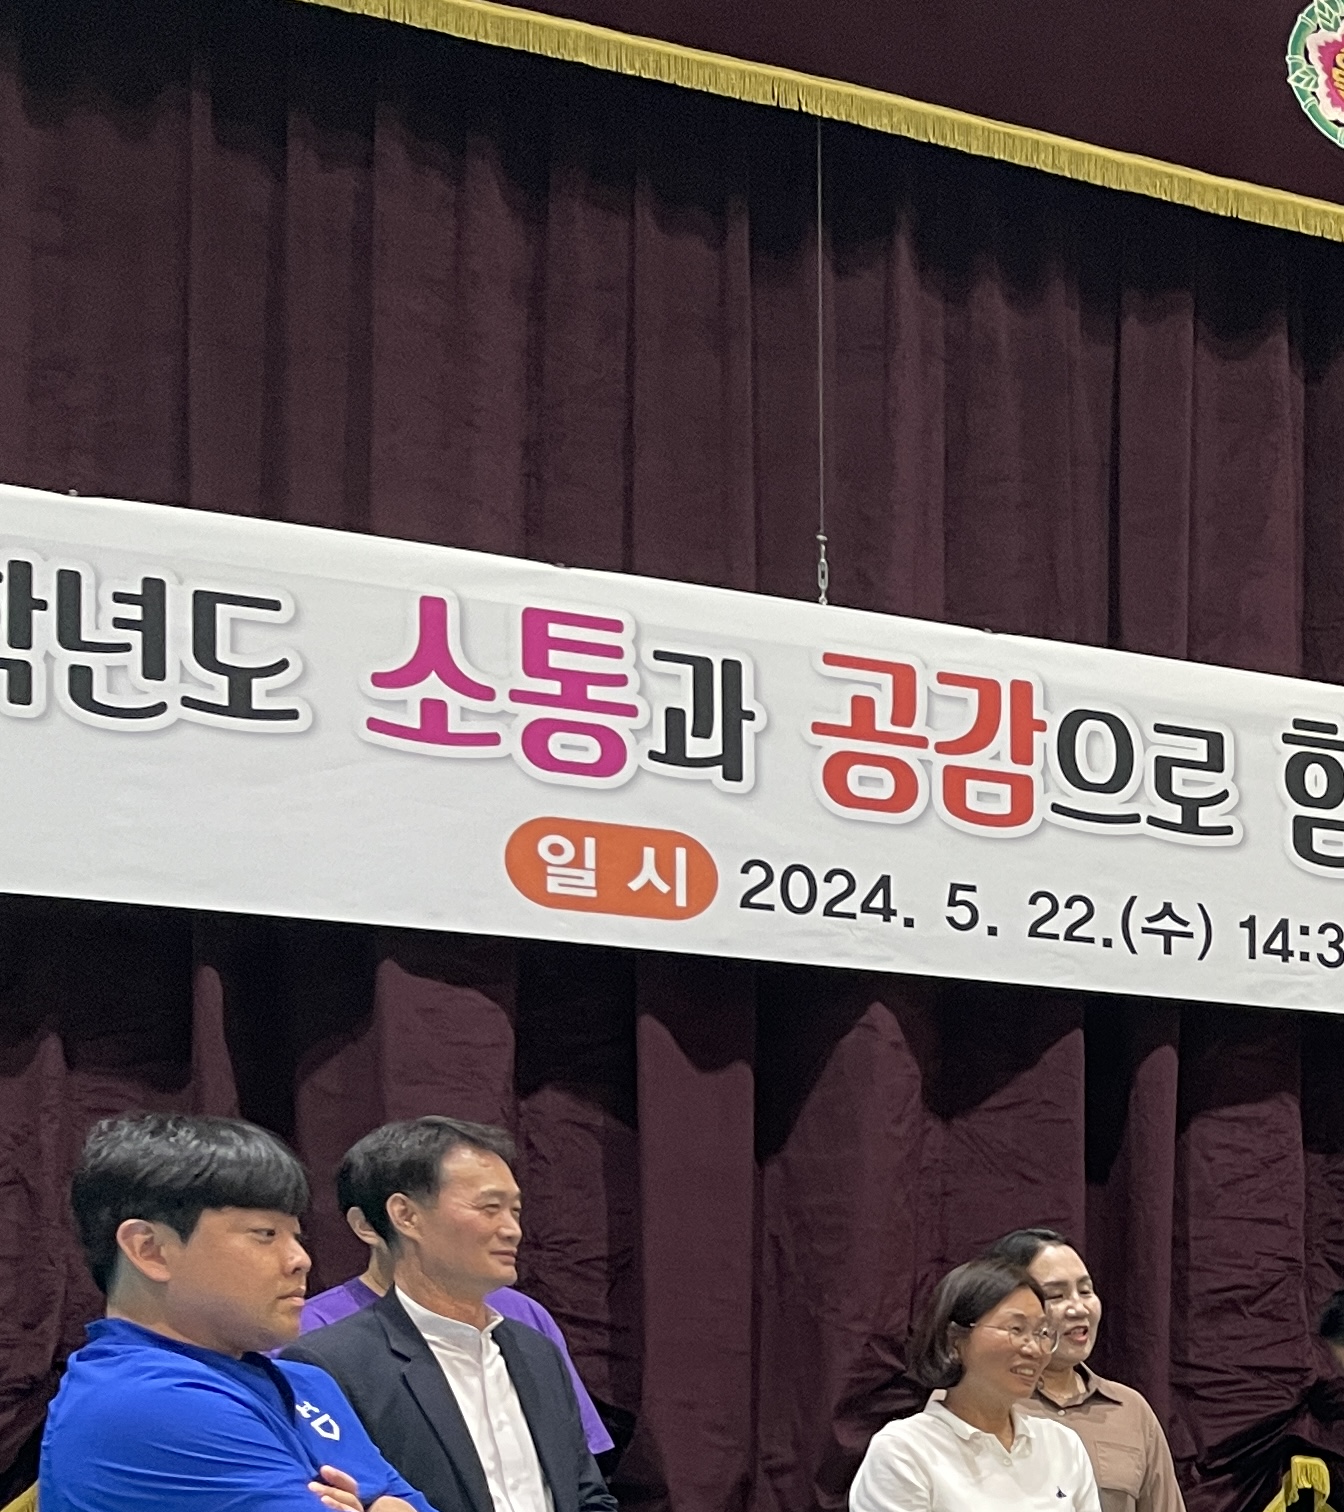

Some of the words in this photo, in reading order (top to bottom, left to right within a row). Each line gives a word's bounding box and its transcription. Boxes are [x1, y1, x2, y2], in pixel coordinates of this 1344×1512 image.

[366, 596, 756, 783] 소통과
[811, 652, 1234, 836] 공감으로
[740, 860, 914, 928] 2024.
[946, 883, 997, 936] 5.
[1028, 893, 1212, 961] 22.(수)
